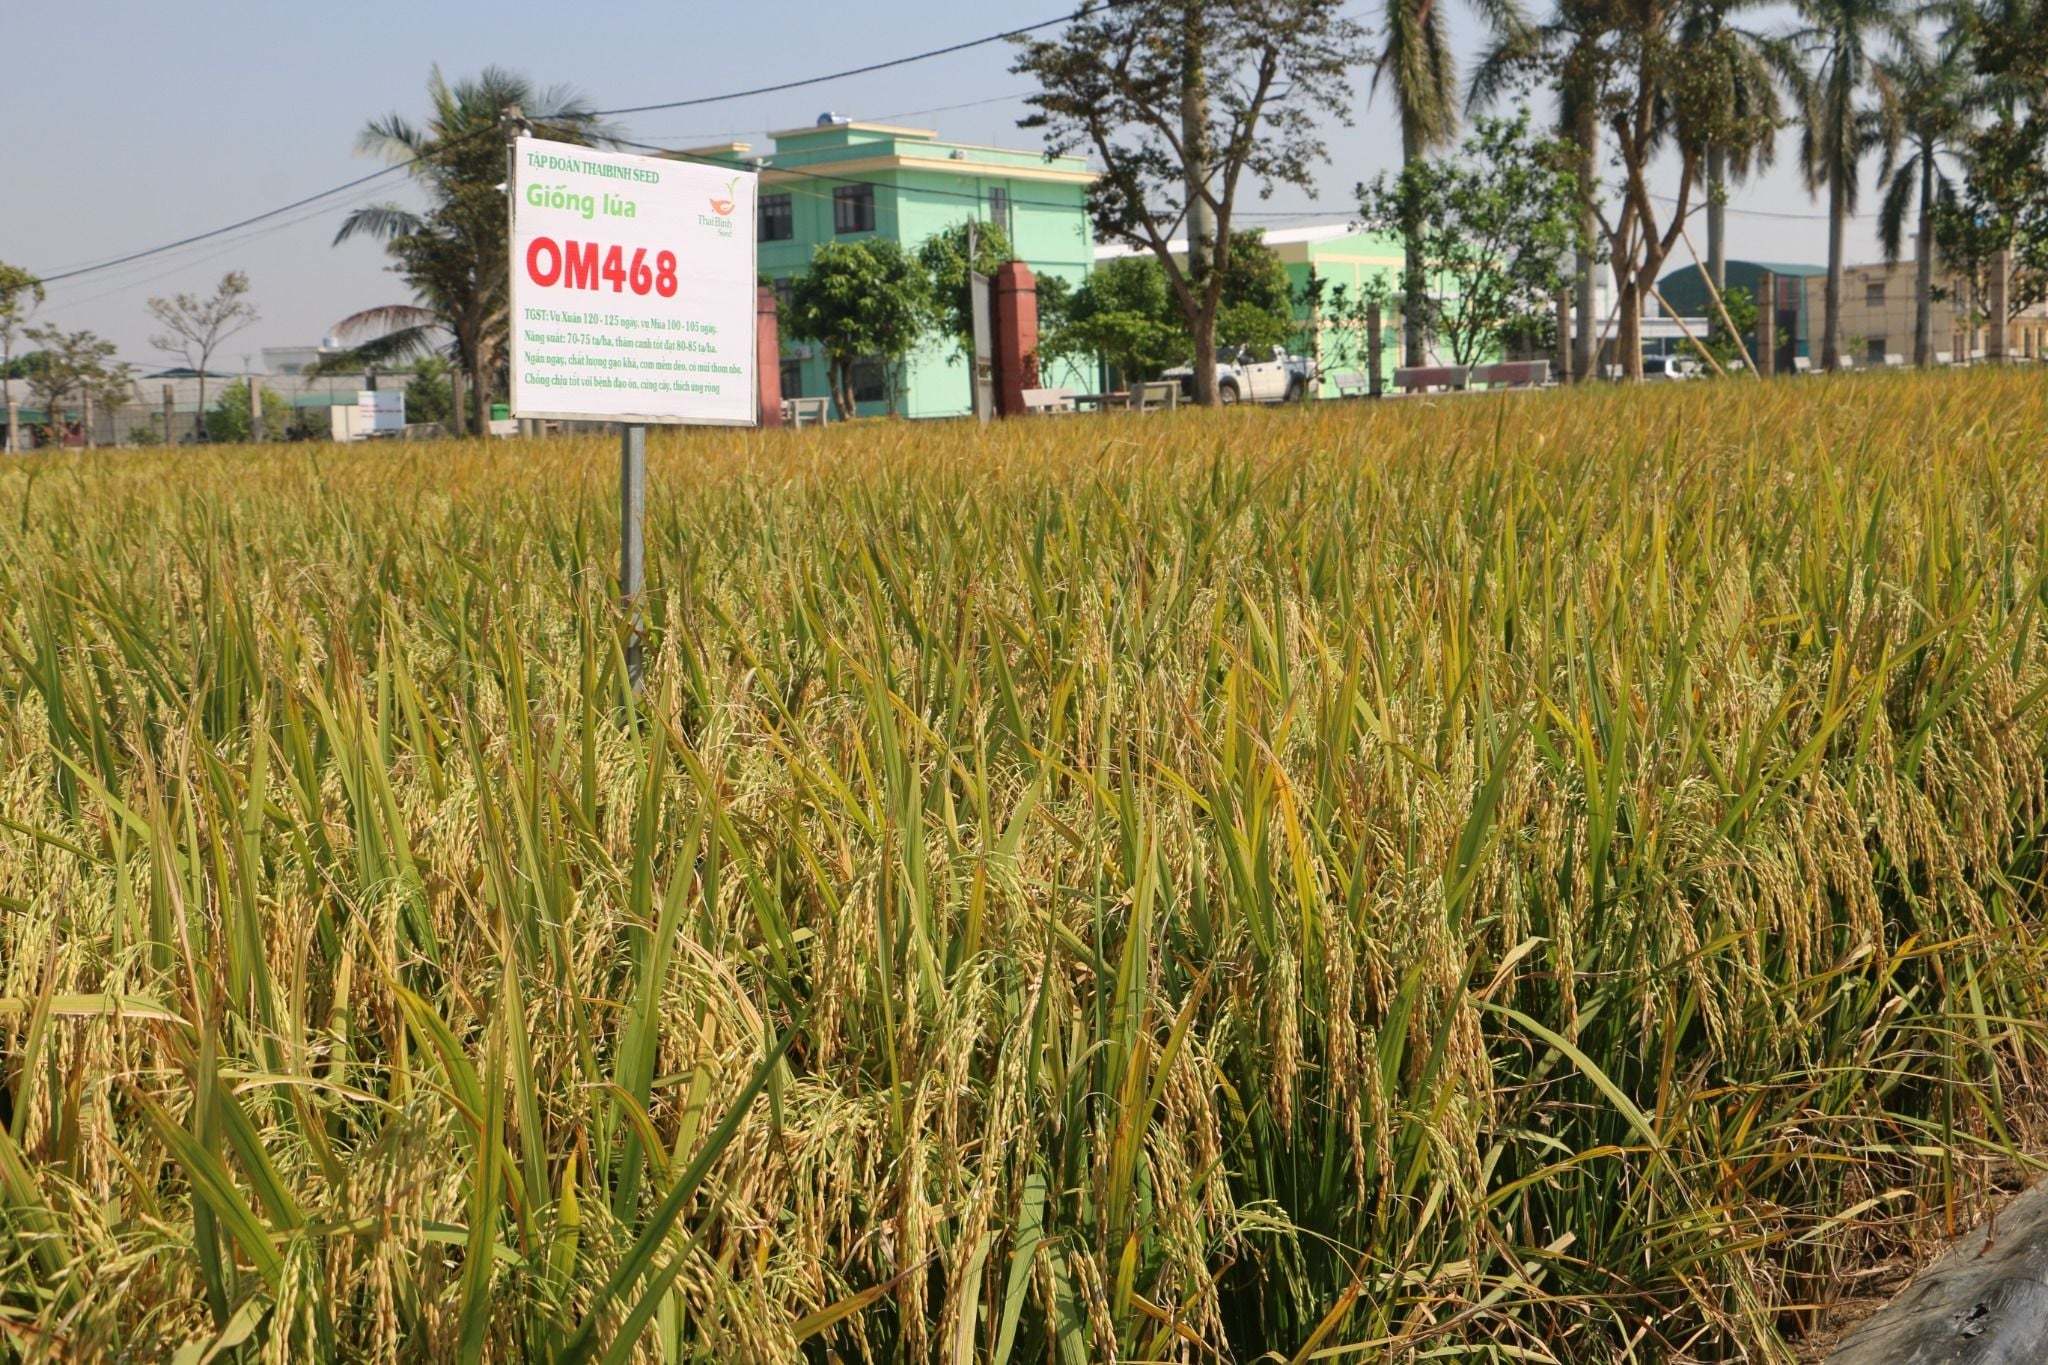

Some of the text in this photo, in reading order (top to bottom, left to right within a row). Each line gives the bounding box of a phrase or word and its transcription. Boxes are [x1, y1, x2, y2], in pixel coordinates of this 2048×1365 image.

[549, 156, 580, 173] ĐOÀN
[582, 161, 632, 180] THAIBINH
[633, 168, 660, 184] SEED
[526, 183, 636, 220] Giống lúa
[526, 236, 678, 298] OM468
[524, 307, 548, 321] TGST:
[583, 312, 599, 325] 120
[604, 314, 619, 327] 125
[667, 319, 681, 331] 100
[686, 321, 699, 332] 105
[567, 332, 590, 345] 70-75
[635, 337, 652, 349] canh
[676, 340, 696, 352] 80-85
